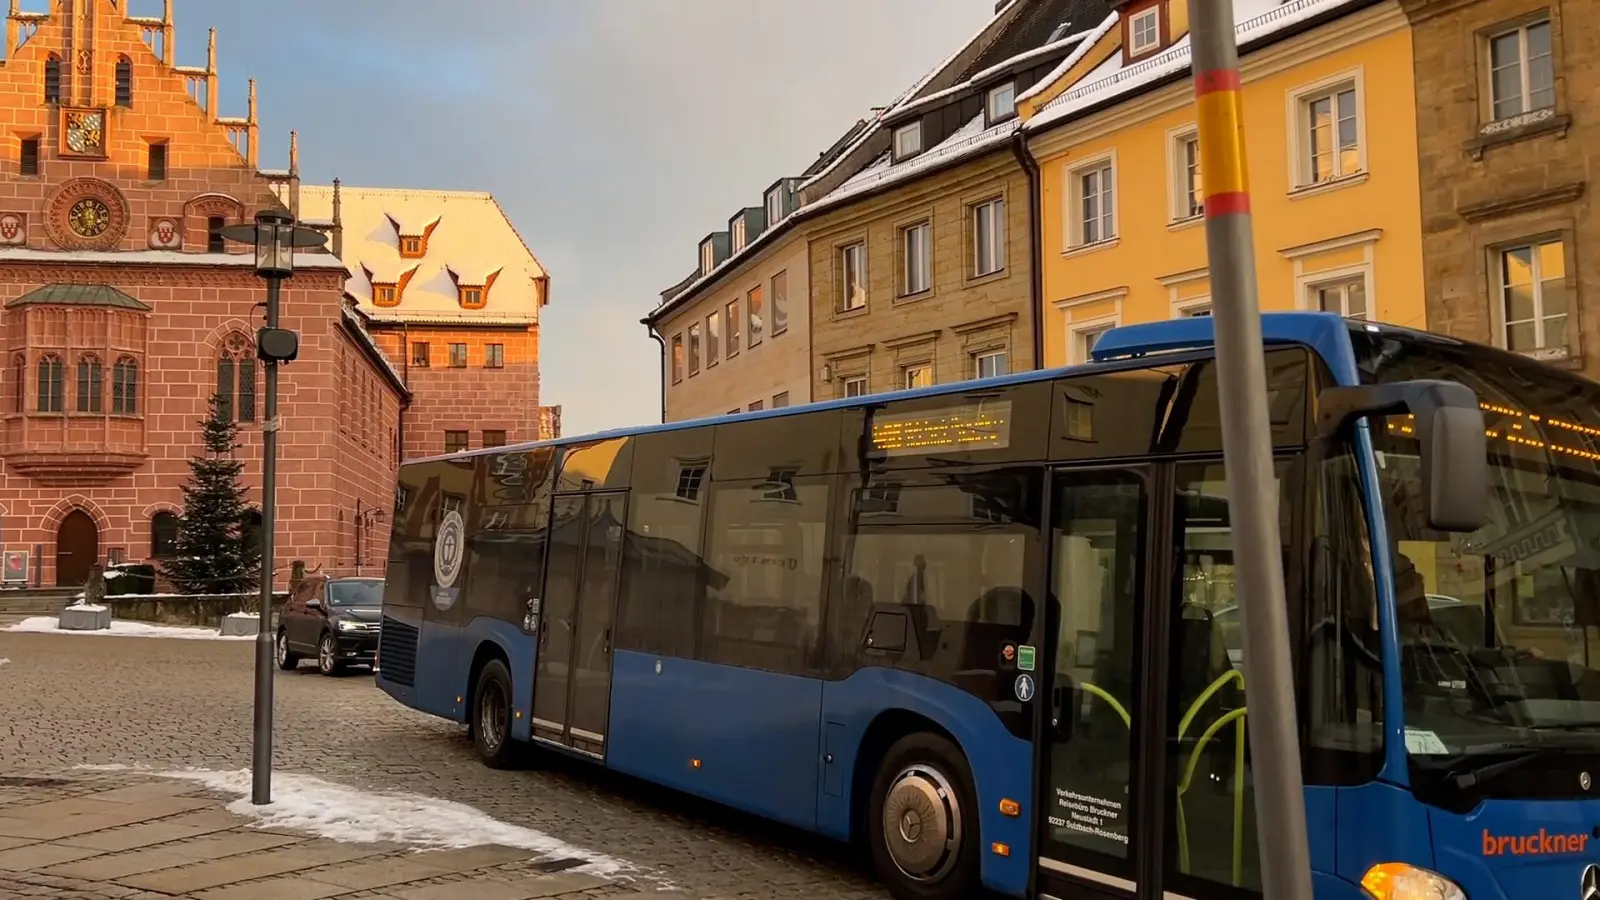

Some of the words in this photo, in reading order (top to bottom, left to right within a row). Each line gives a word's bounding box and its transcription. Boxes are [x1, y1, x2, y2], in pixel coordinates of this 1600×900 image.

[1056, 788, 1122, 809] Verkehrsunternehmen
[1059, 798, 1089, 812] Reisebüro
[1090, 805, 1118, 818] Bruckner
[1071, 811, 1099, 825] Neustadt
[1100, 818, 1103, 826] 1
[1048, 816, 1065, 826] 92237
[1066, 820, 1129, 844] Sulzbach-Rosenberg
[1482, 828, 1589, 856] bruckner
